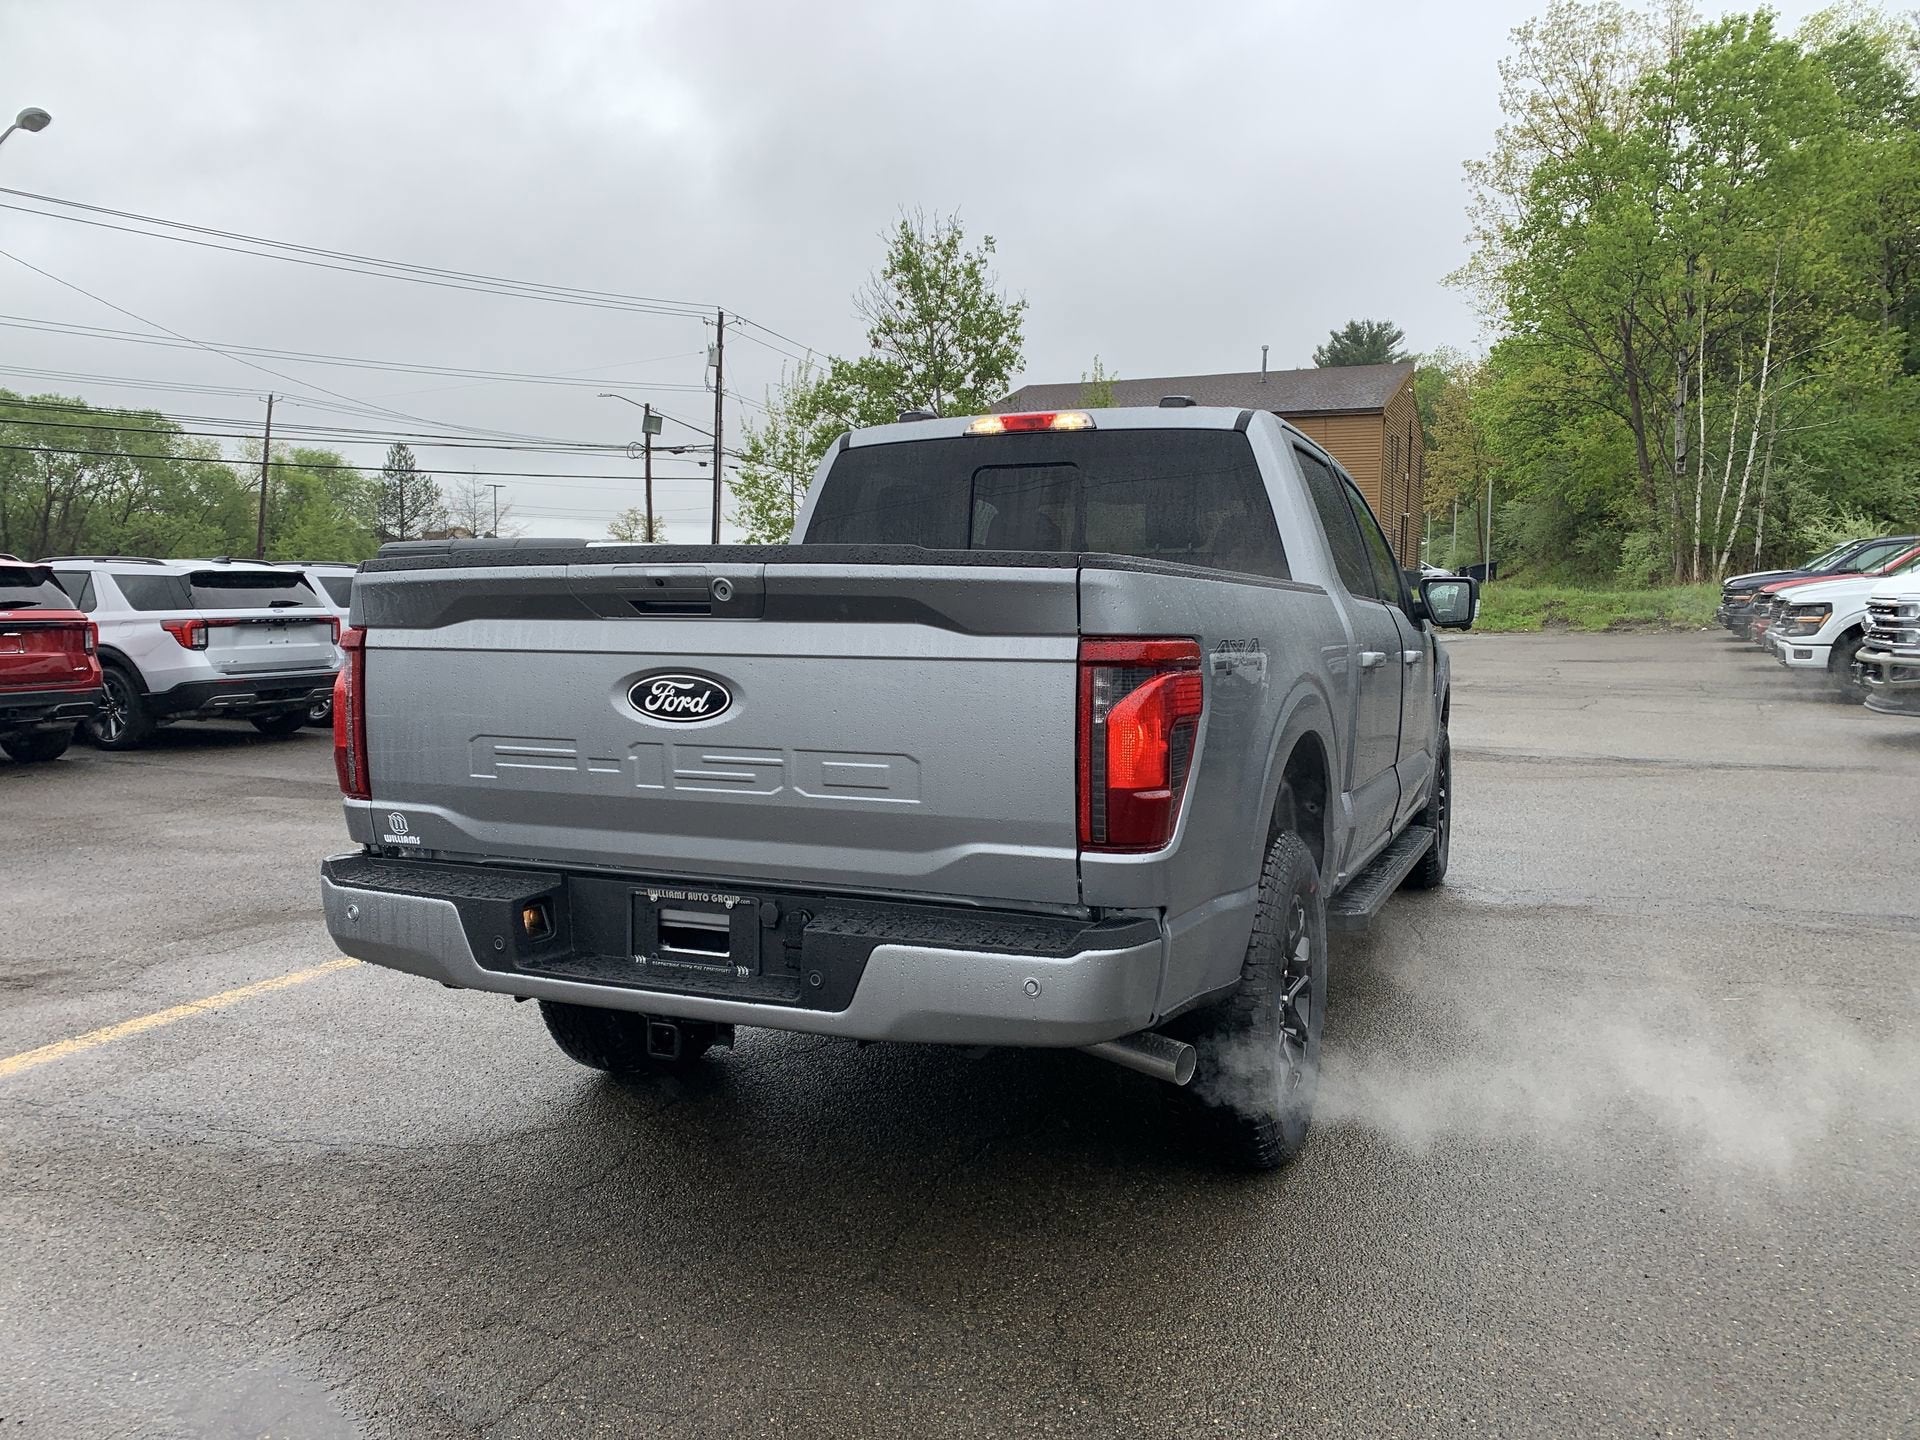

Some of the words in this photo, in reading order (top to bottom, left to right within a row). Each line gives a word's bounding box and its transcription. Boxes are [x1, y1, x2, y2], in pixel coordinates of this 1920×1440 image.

[645, 681, 711, 713] Ford
[469, 733, 922, 804] F-150
[383, 834, 420, 845] WILLIAMS
[687, 892, 709, 902] AUTO
